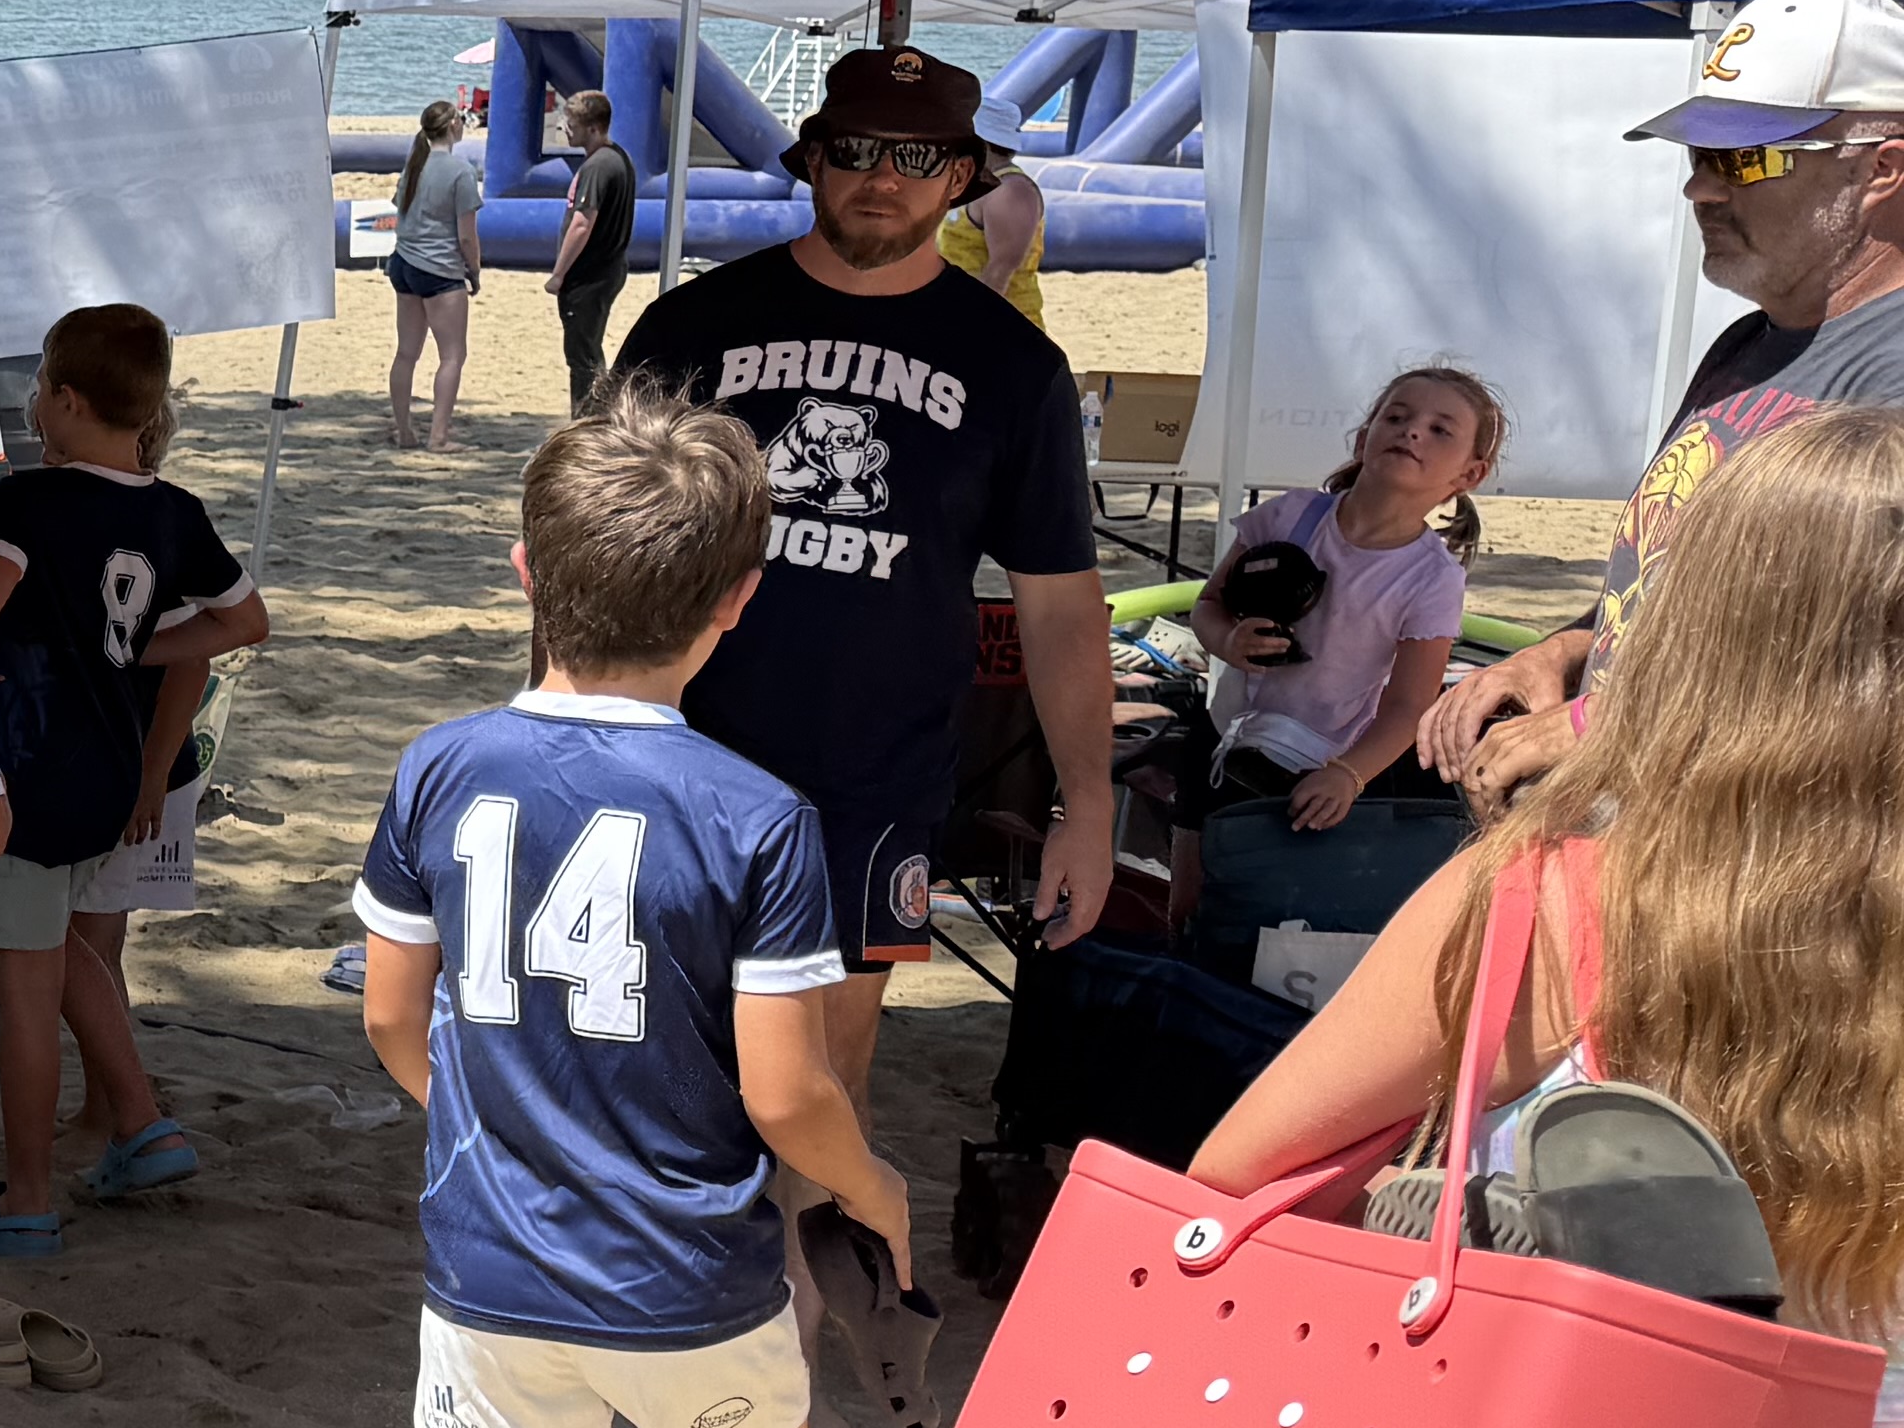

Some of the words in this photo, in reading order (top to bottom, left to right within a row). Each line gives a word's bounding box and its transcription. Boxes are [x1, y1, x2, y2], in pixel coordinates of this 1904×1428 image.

[1702, 23, 1755, 82] L
[716, 339, 967, 430] BRUINS
[1155, 420, 1180, 437] logi
[453, 794, 647, 1042] 14
[1186, 1225, 1206, 1249] b
